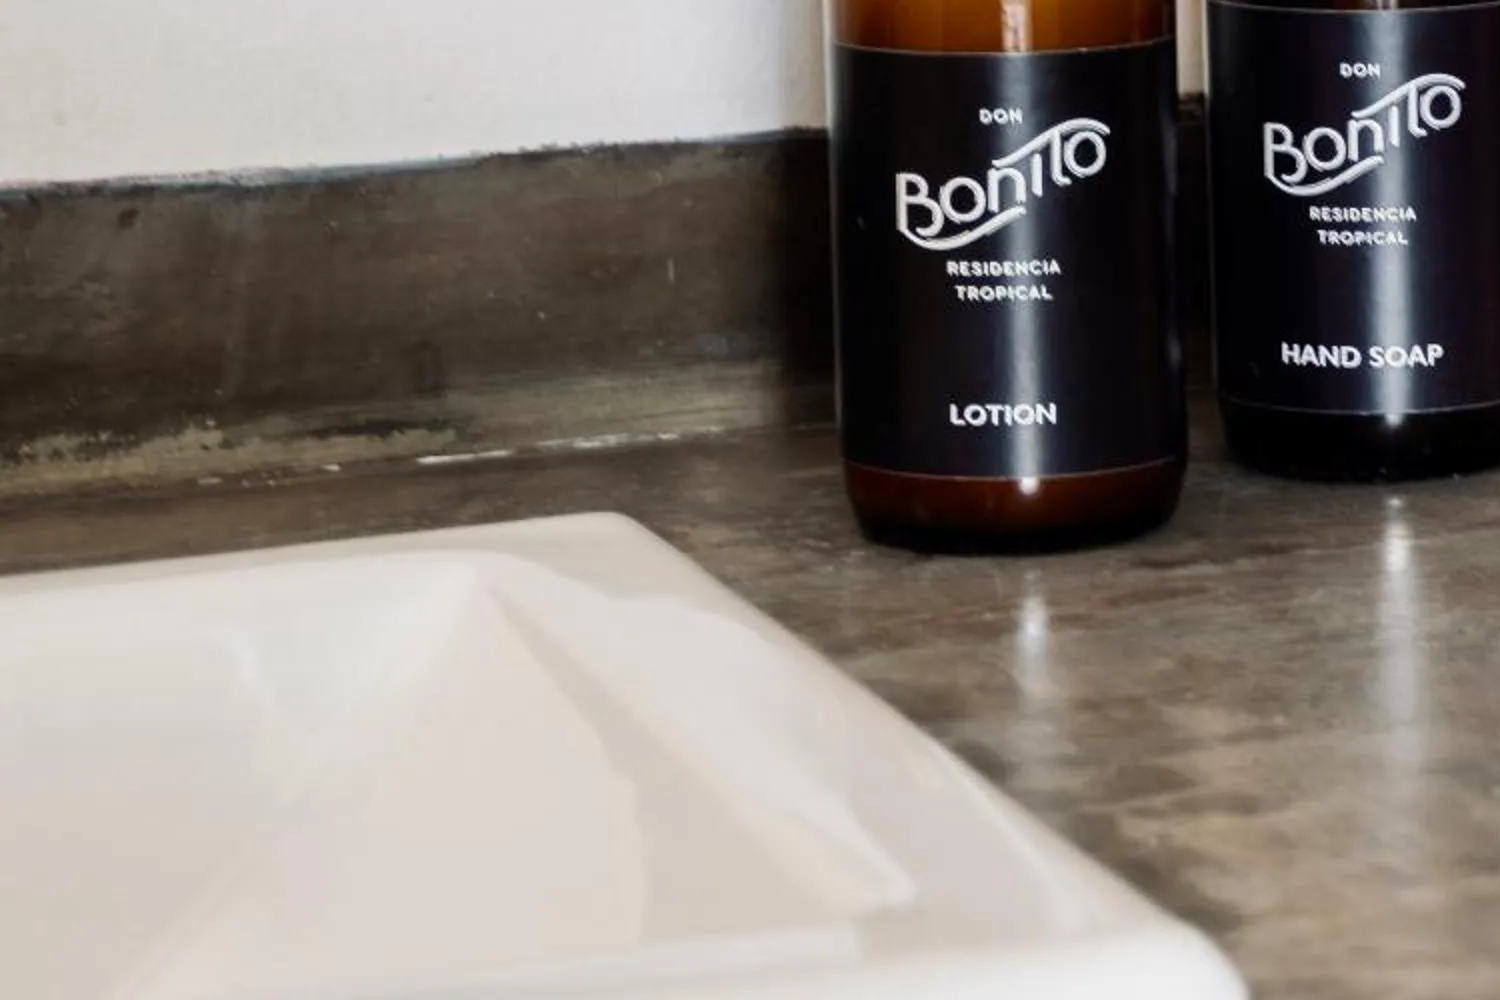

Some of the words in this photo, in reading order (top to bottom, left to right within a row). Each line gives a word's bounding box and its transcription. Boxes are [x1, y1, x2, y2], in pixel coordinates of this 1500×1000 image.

[1340, 62, 1381, 79] DON
[978, 107, 1024, 125] DON
[1309, 205, 1417, 223] RESIDENCIA
[1317, 229, 1409, 246] TROPICAL
[946, 258, 1062, 278] RESIDENCIA
[955, 284, 1054, 302] TROPICAL
[1280, 341, 1362, 369] HAND
[1368, 342, 1444, 369] SOAP
[949, 402, 1058, 427] LOTION
